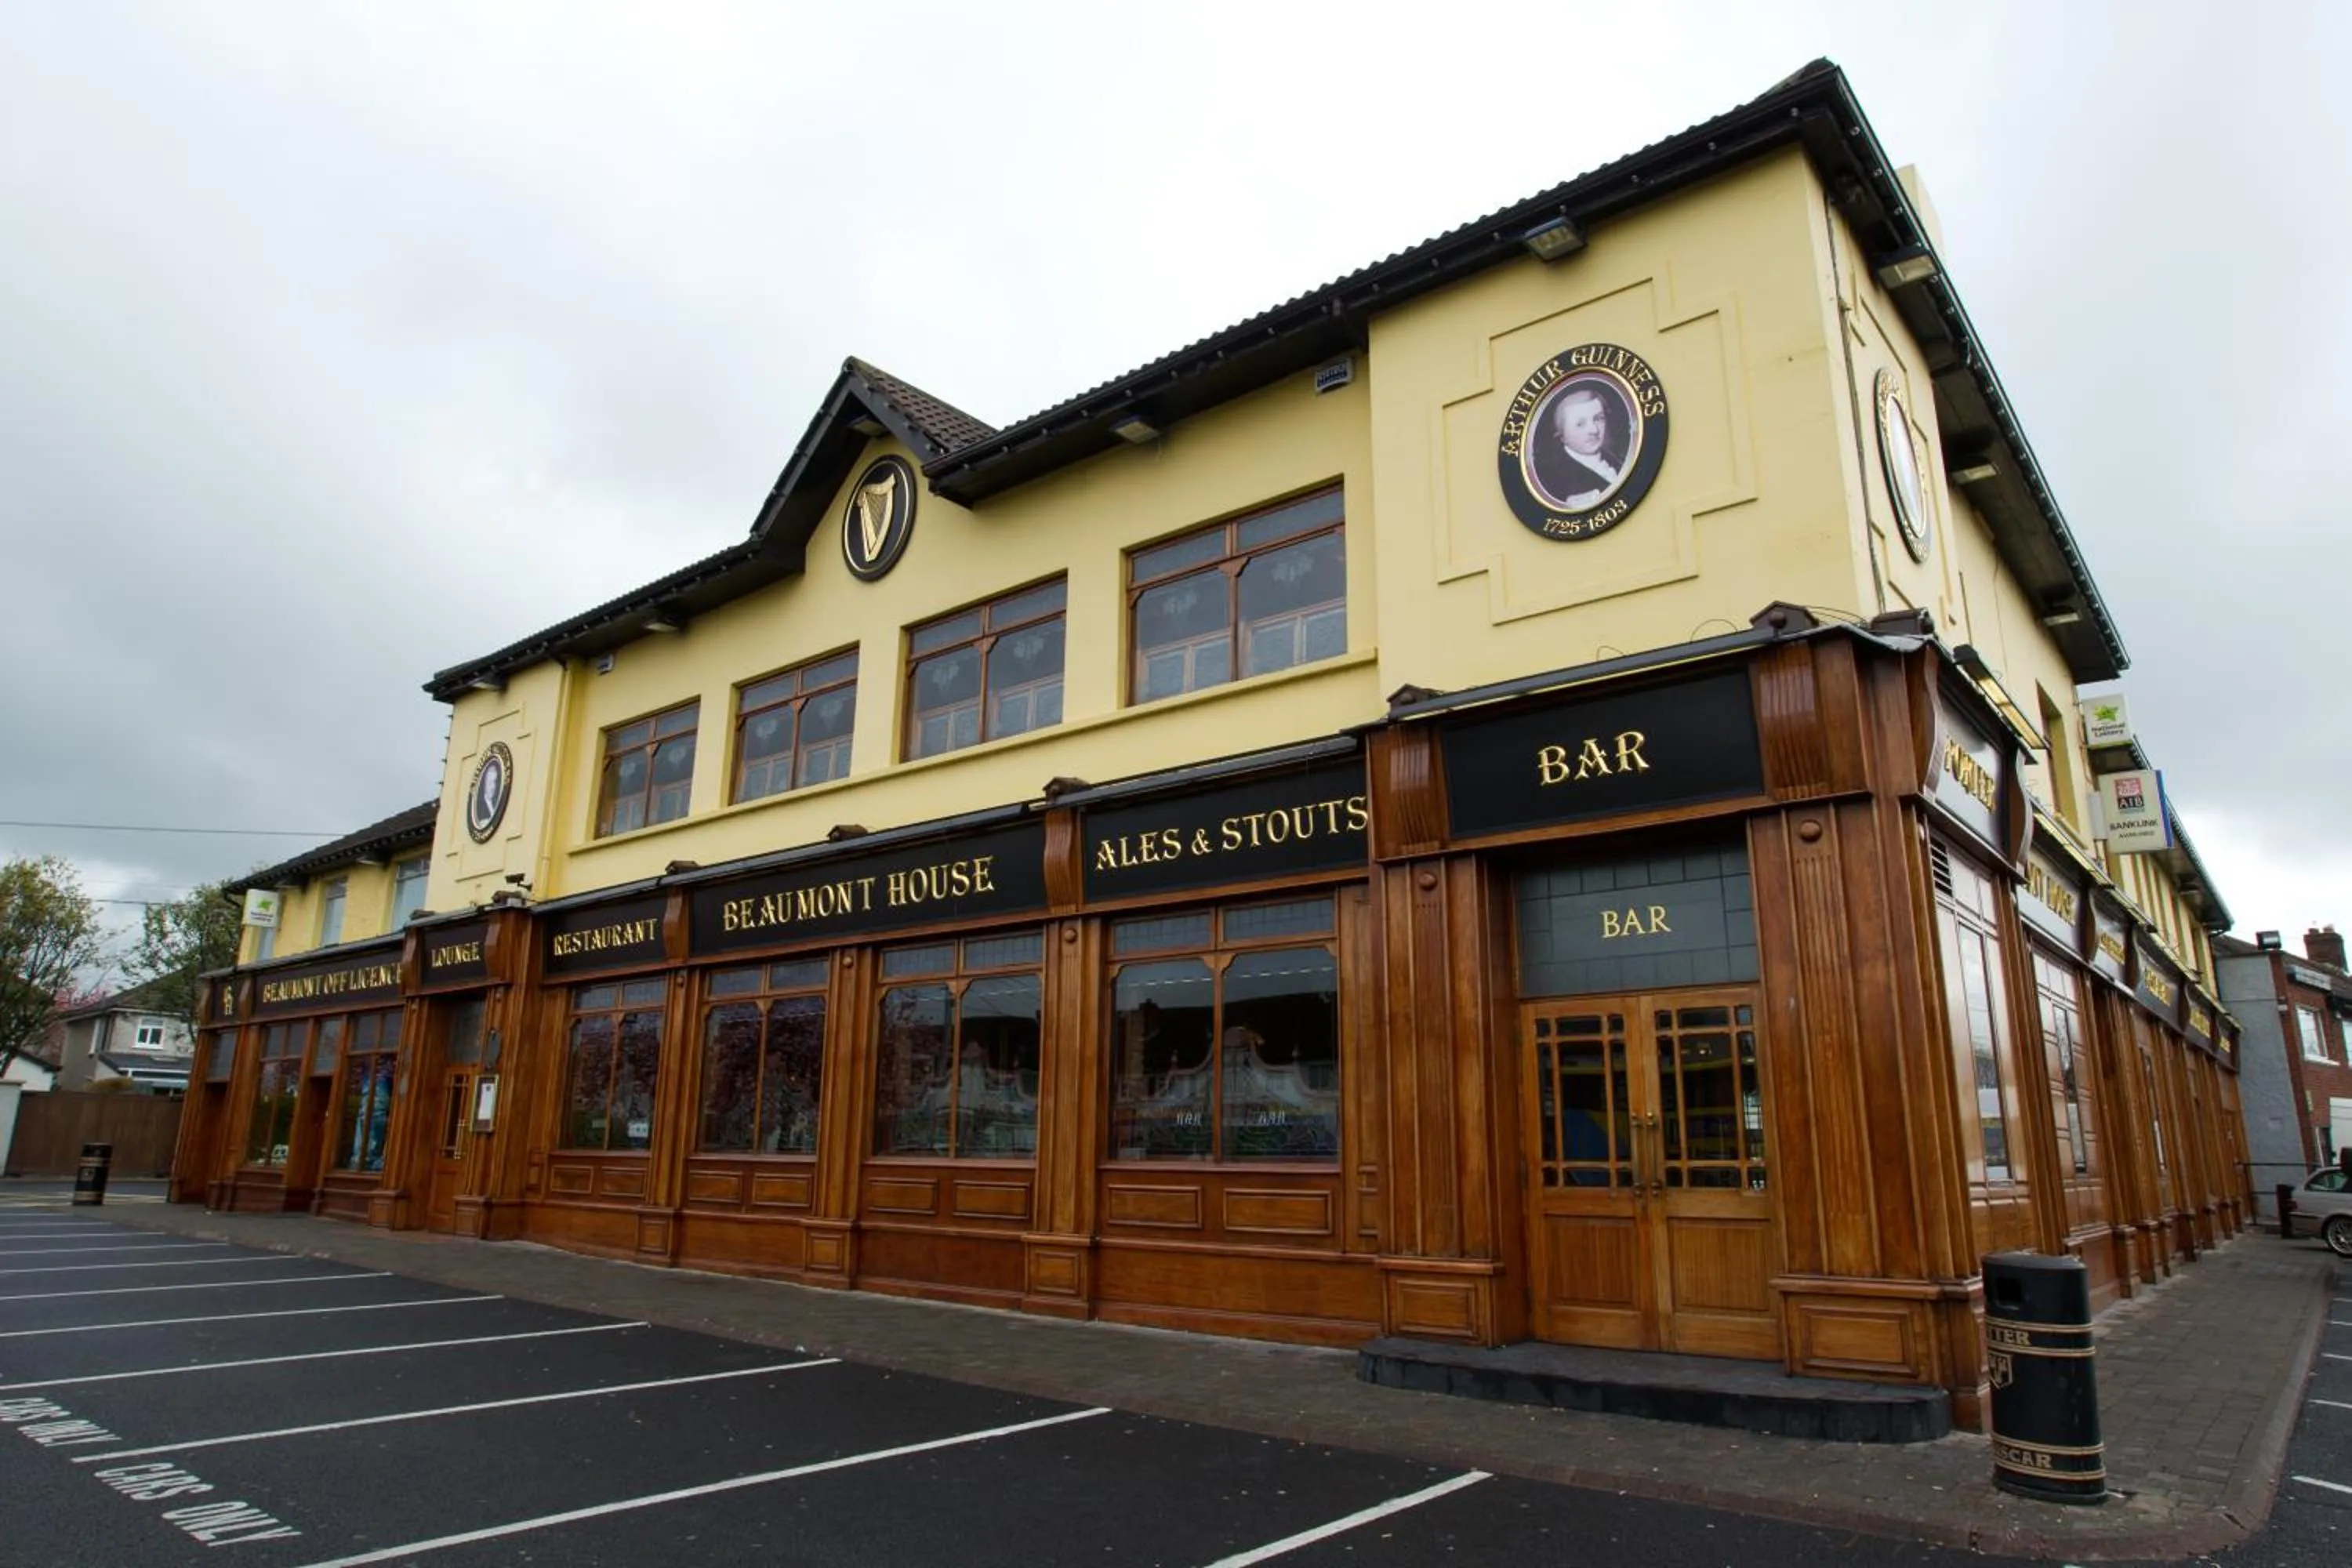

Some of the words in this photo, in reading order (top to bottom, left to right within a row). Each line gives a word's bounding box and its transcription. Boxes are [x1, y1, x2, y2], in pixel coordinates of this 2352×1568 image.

[1501, 360, 1565, 458] ARTHUR
[1570, 346, 1665, 417] GUINNESS
[1543, 499, 1629, 535] 1725-1803
[1537, 731, 1650, 786] BAR
[2119, 795, 2143, 809] AIB
[1094, 828, 1182, 871] ALES
[1191, 828, 1214, 857] &
[1221, 795, 1370, 851] STOUTS
[723, 877, 877, 932] BEAUMONT
[887, 855, 996, 908] HOUSE
[554, 918, 658, 956] RESTAURANT
[1600, 905, 1672, 938] BAR
[431, 942, 481, 967] LOUNGE
[263, 975, 324, 1004] BEAUMONT
[324, 971, 348, 995] OFF
[1986, 1326, 2031, 1346] TTER
[17, 1419, 122, 1447] ONLY
[94, 1462, 215, 1501] CARS
[162, 1501, 303, 1547] ONLY
